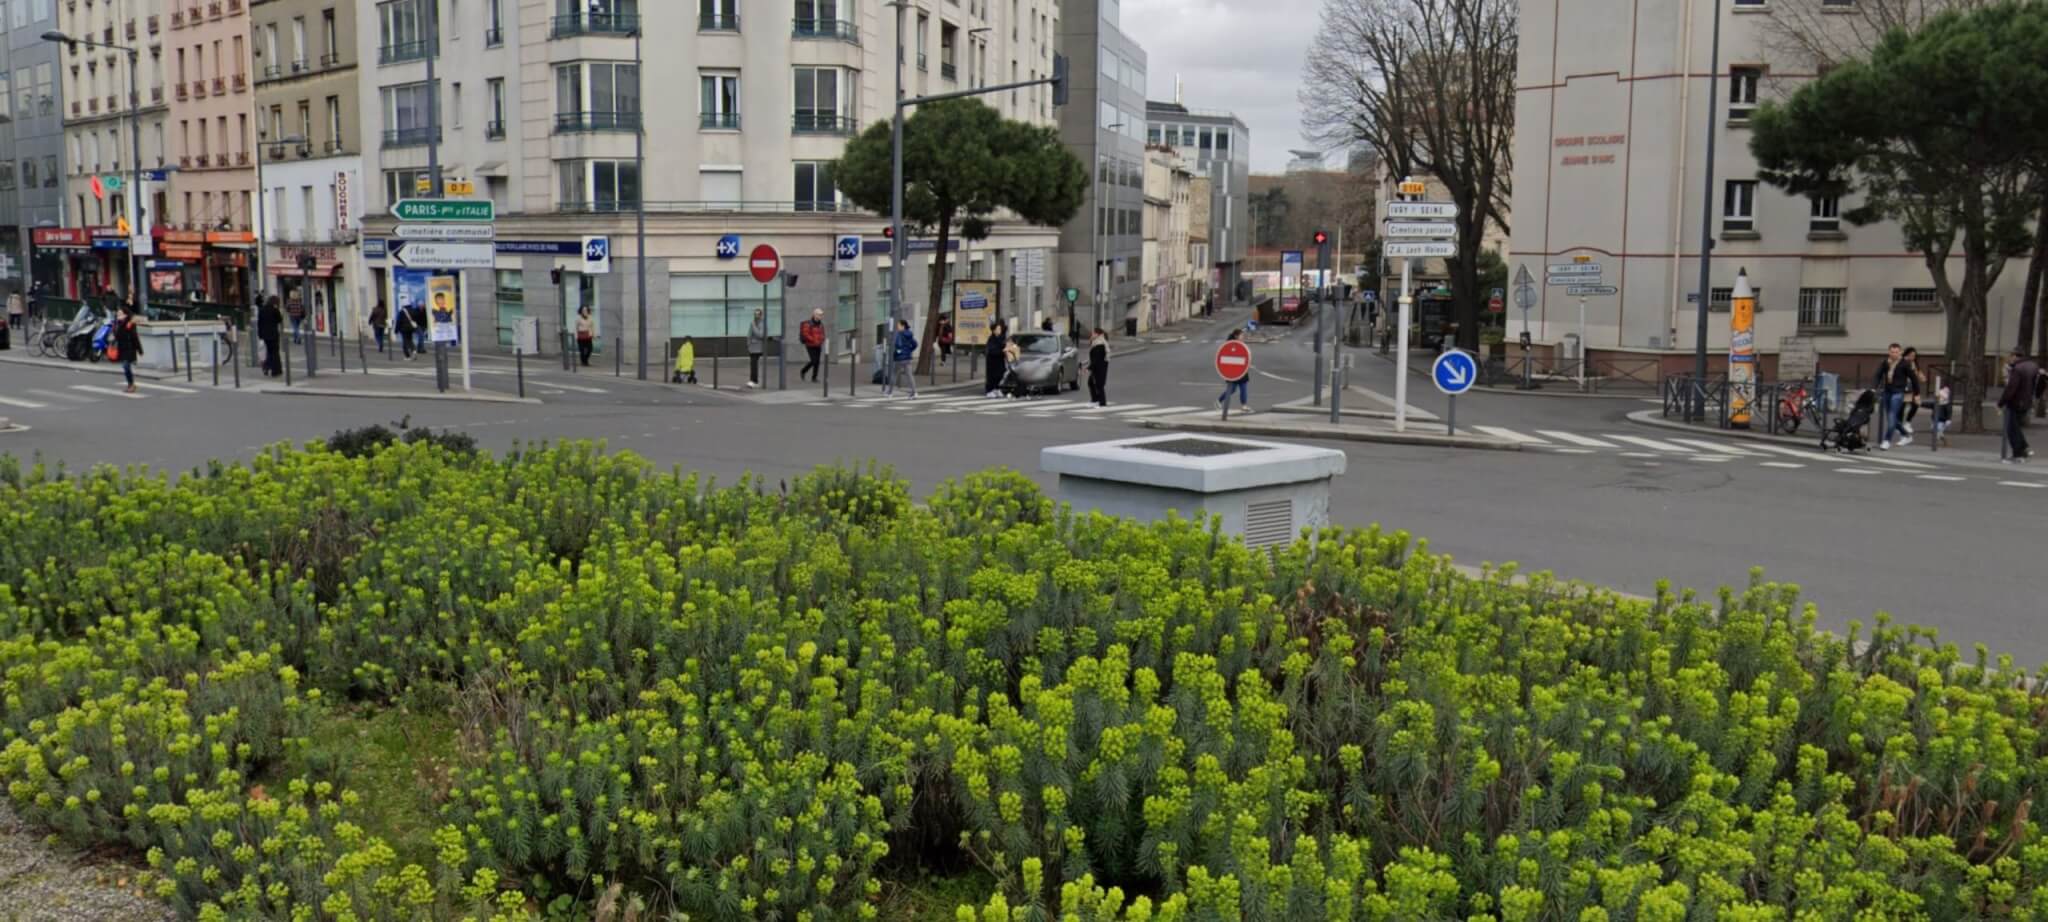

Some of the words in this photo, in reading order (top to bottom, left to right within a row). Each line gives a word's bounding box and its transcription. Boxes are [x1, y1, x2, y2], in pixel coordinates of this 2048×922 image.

[338, 171, 348, 231] BOUCHERIE
[1421, 206, 1443, 214] SEINE
[446, 226, 491, 236] communal
